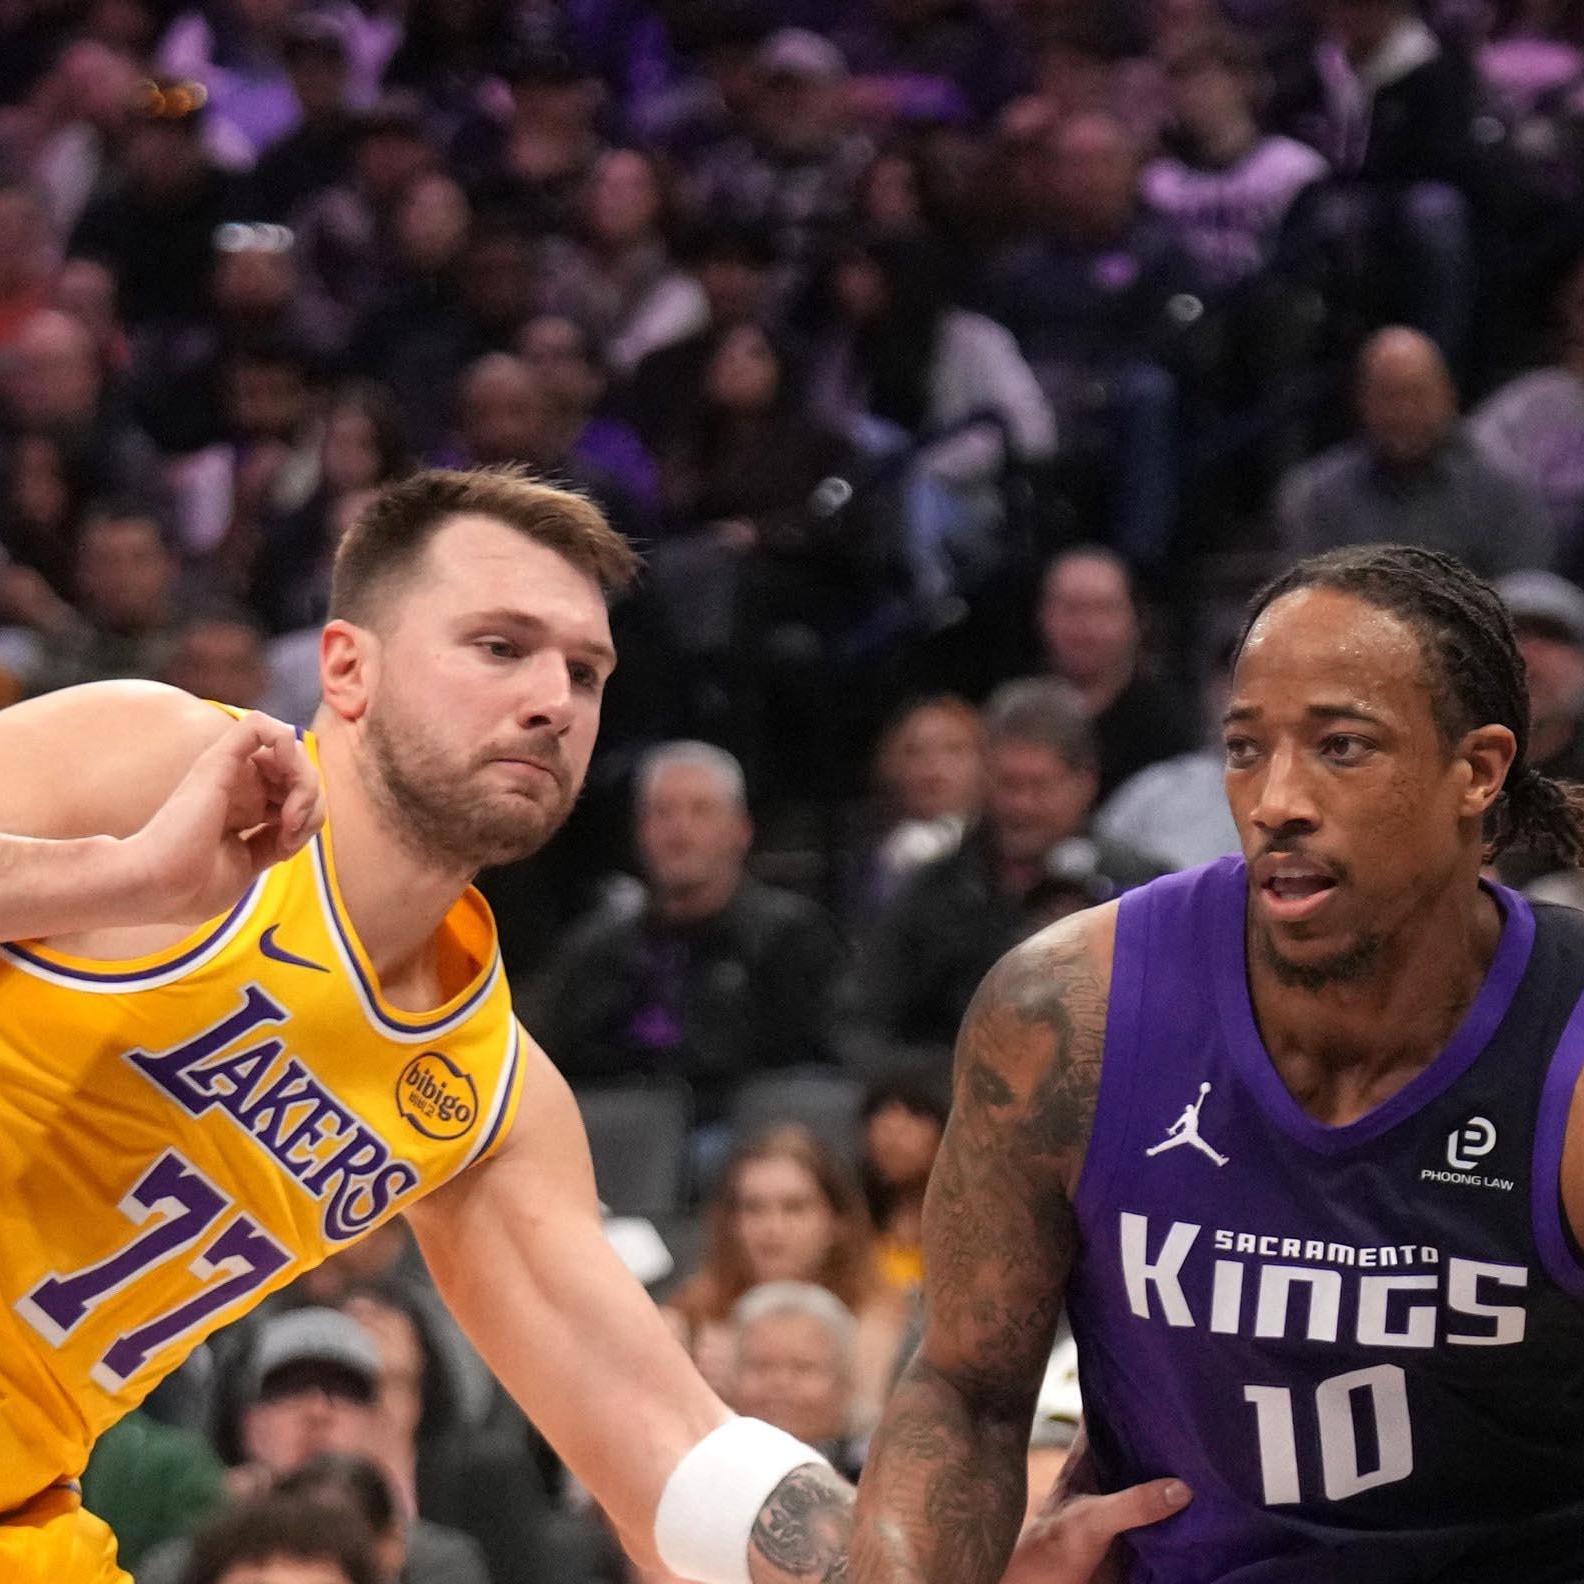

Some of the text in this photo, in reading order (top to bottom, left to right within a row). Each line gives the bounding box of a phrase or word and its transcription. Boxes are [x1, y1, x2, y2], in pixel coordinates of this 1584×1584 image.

[122, 981, 421, 1241] LAKERS
[405, 1062, 471, 1122] bibigo
[1214, 1229, 1440, 1268] SACRAMENTO
[1421, 1169, 1514, 1192] PHOONG LAW
[13, 1145, 298, 1396] 77
[1120, 1210, 1529, 1349] KINGS
[1243, 1362, 1414, 1506] 10
